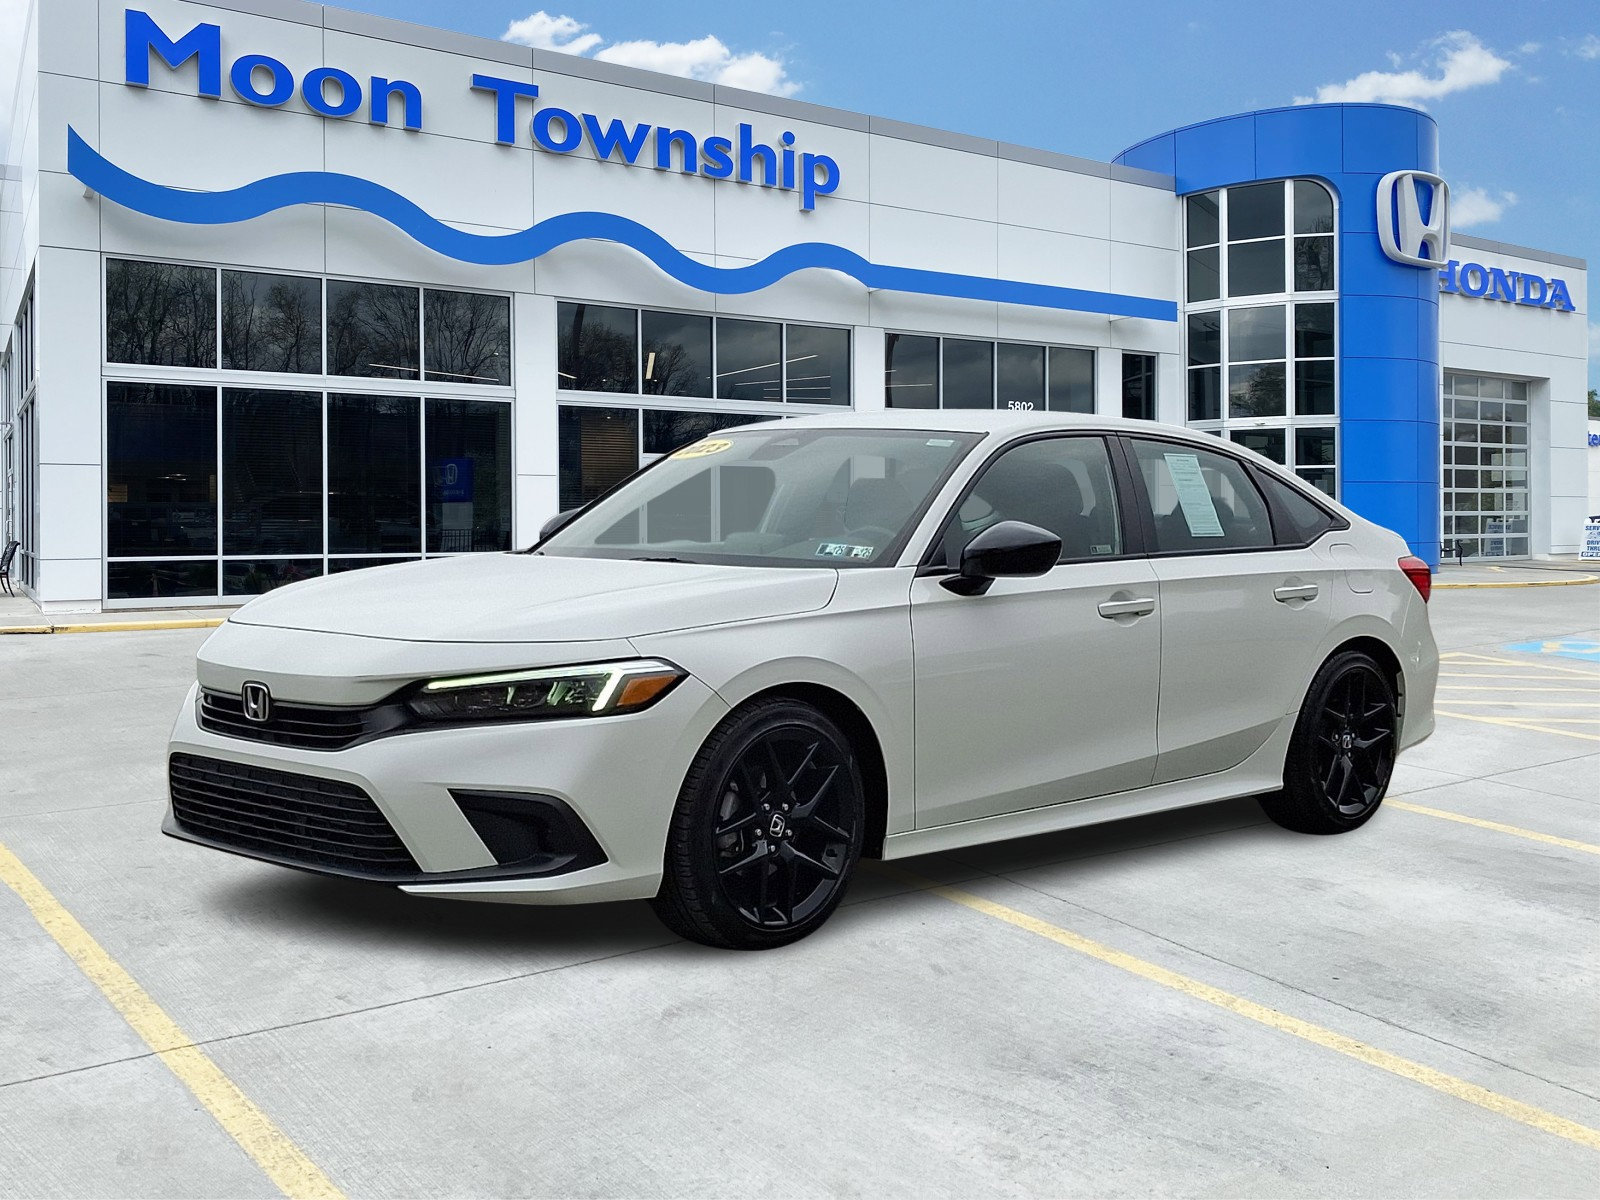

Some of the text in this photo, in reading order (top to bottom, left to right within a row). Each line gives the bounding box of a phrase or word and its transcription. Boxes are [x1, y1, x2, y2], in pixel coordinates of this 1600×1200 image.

[124, 8, 841, 212] Moon Township
[1439, 259, 1576, 312] HONDA
[1007, 400, 1034, 411] 5802
